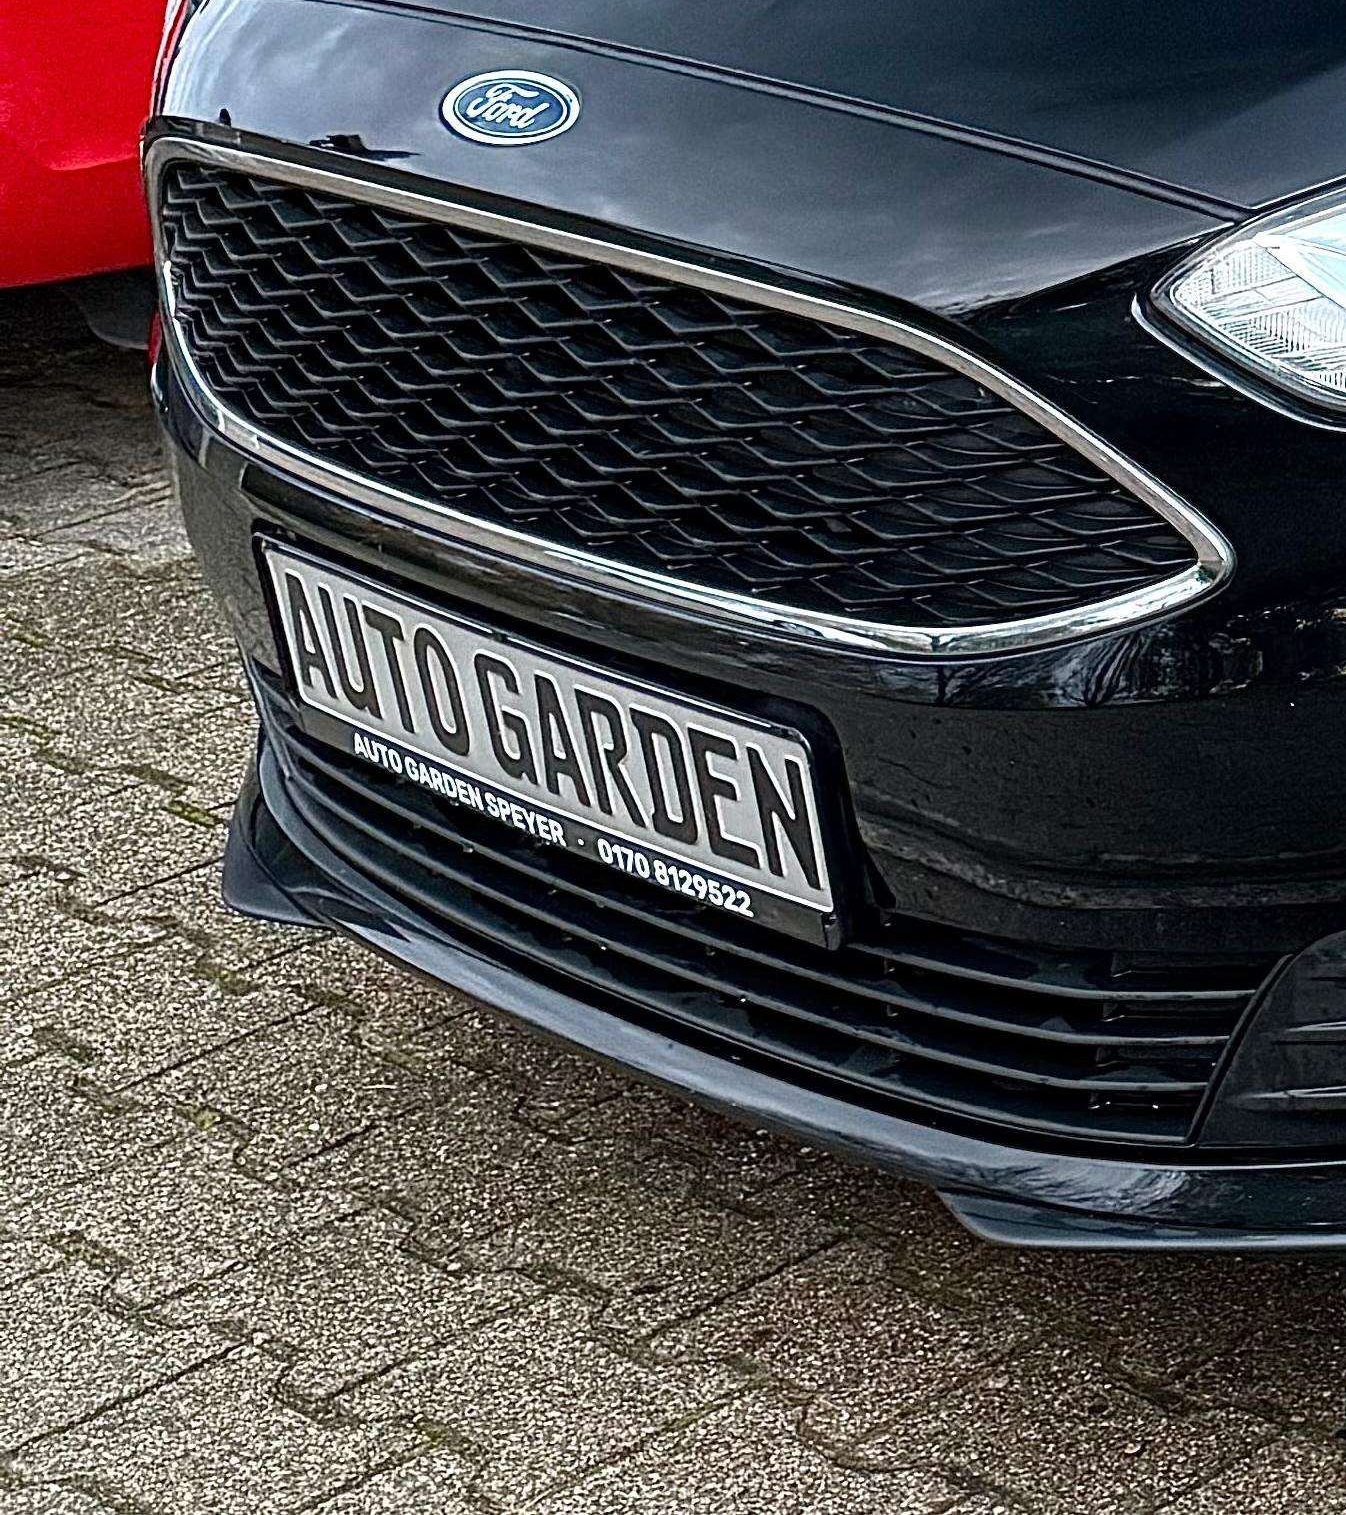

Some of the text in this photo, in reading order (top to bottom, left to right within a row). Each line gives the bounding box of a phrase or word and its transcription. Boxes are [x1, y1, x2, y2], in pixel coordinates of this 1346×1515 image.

[466, 83, 550, 129] Ford
[284, 569, 823, 891] AUTO GARDEN
[353, 731, 756, 919] AUTO GARDEN SPEYER 0170 8129522
